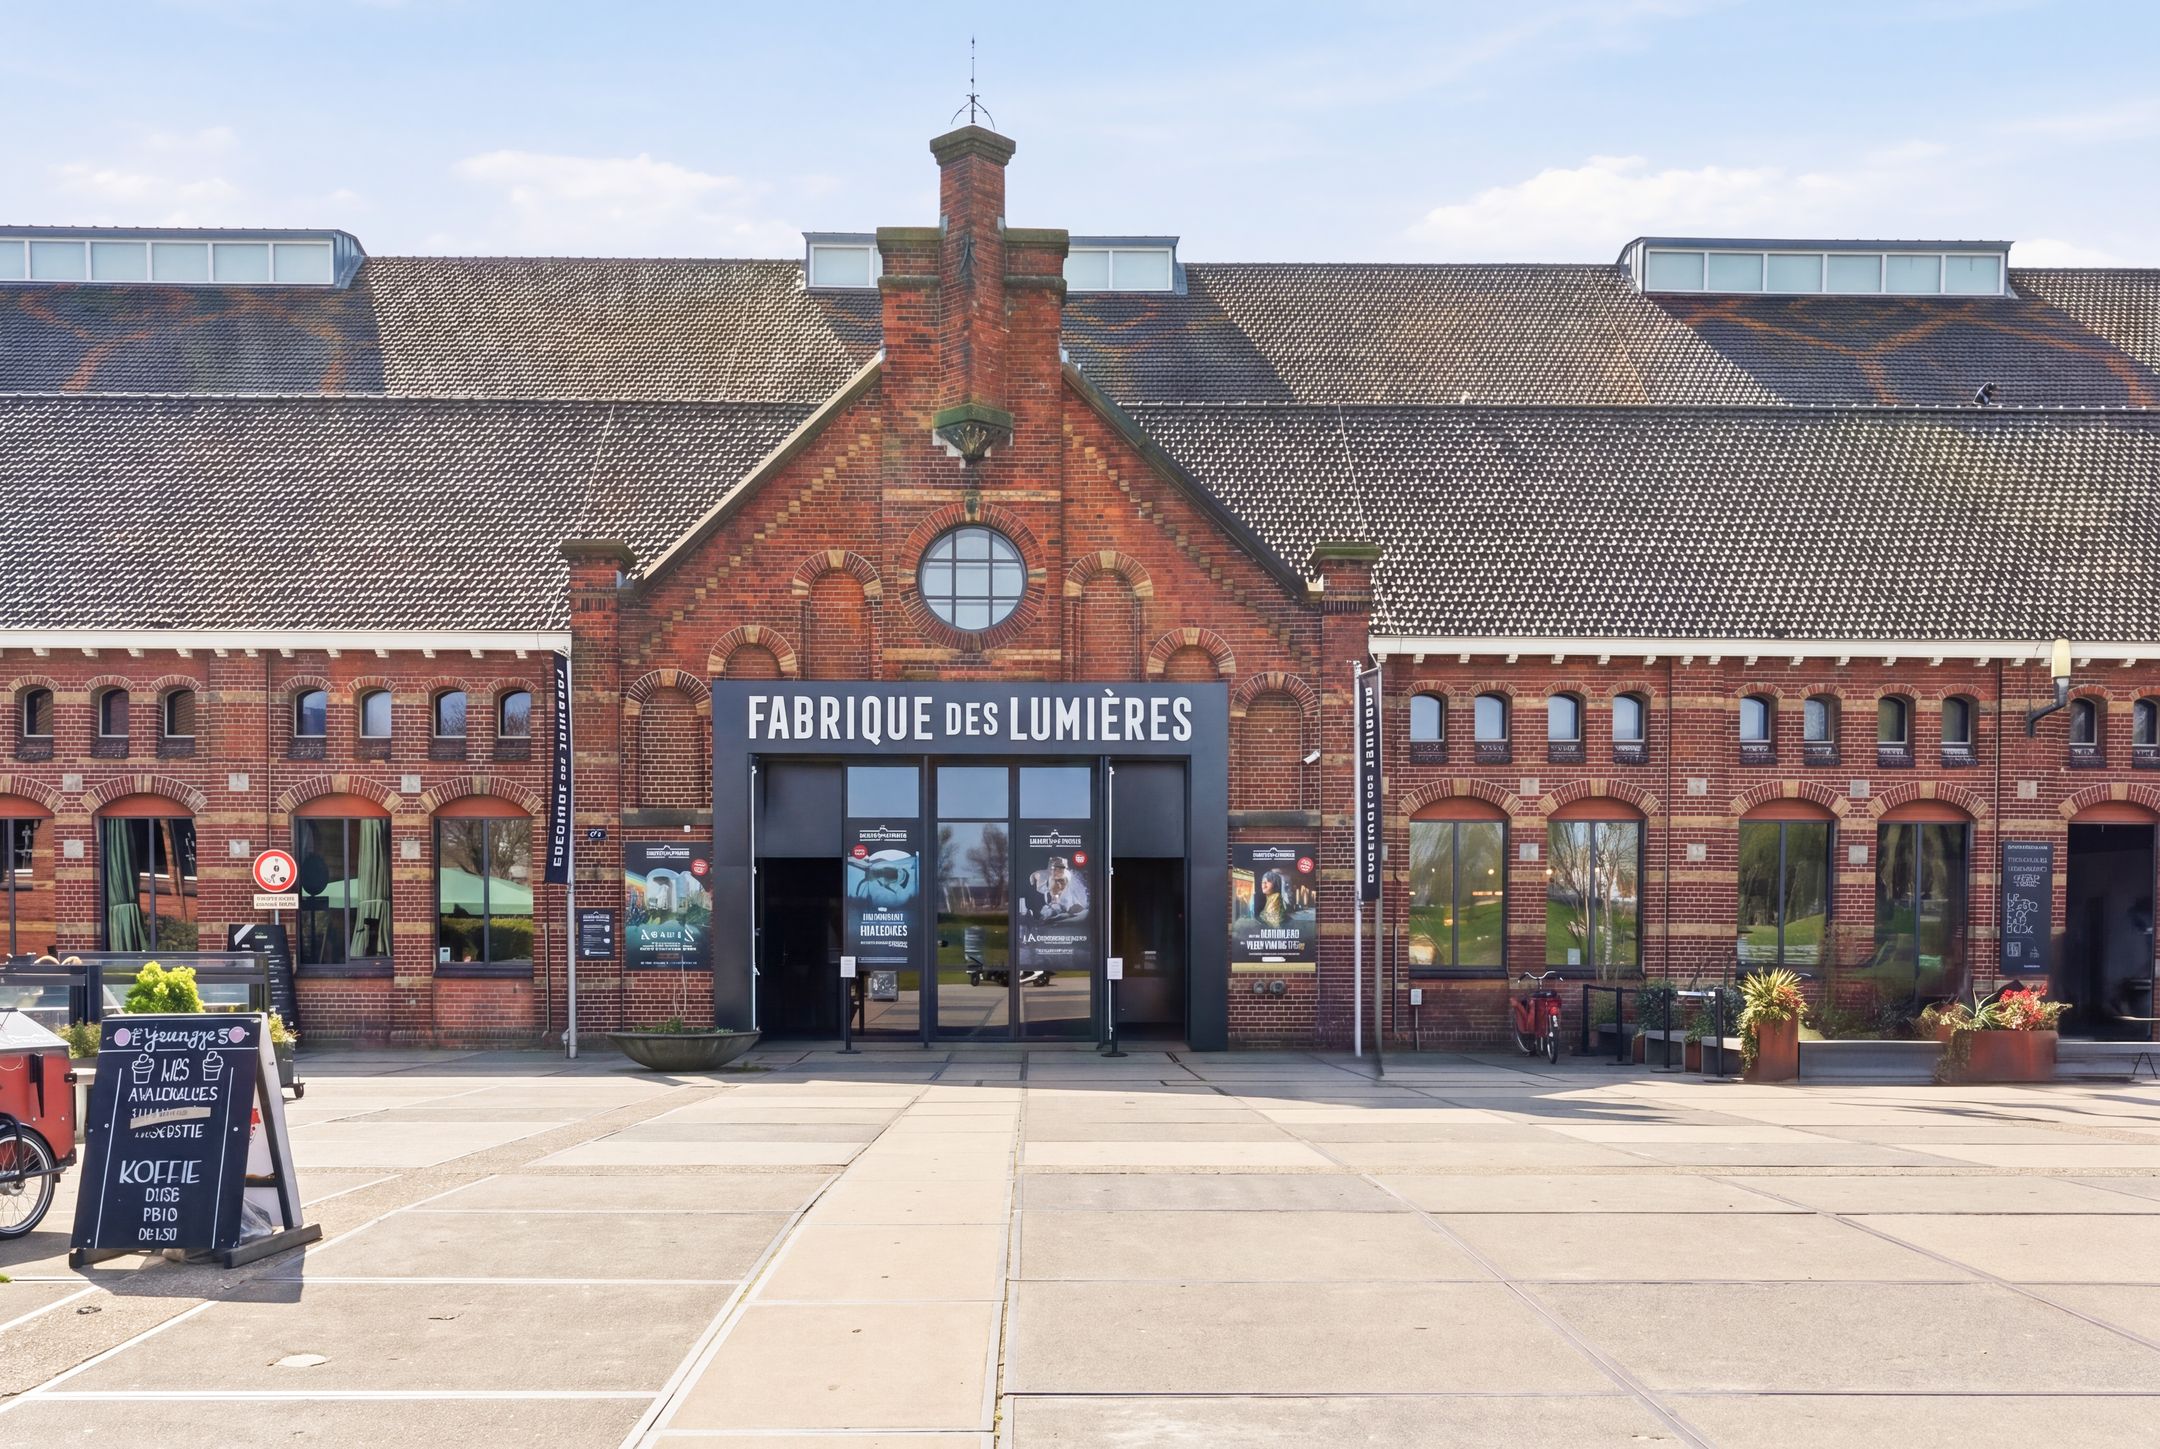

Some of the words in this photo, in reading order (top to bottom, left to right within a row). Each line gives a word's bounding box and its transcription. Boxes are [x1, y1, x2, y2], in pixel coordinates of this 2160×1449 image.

[748, 695, 933, 746] FABRIQUE
[945, 702, 998, 736] DES
[1010, 687, 1193, 742] LUMIÈRES
[119, 1159, 202, 1184] KOFFIE
